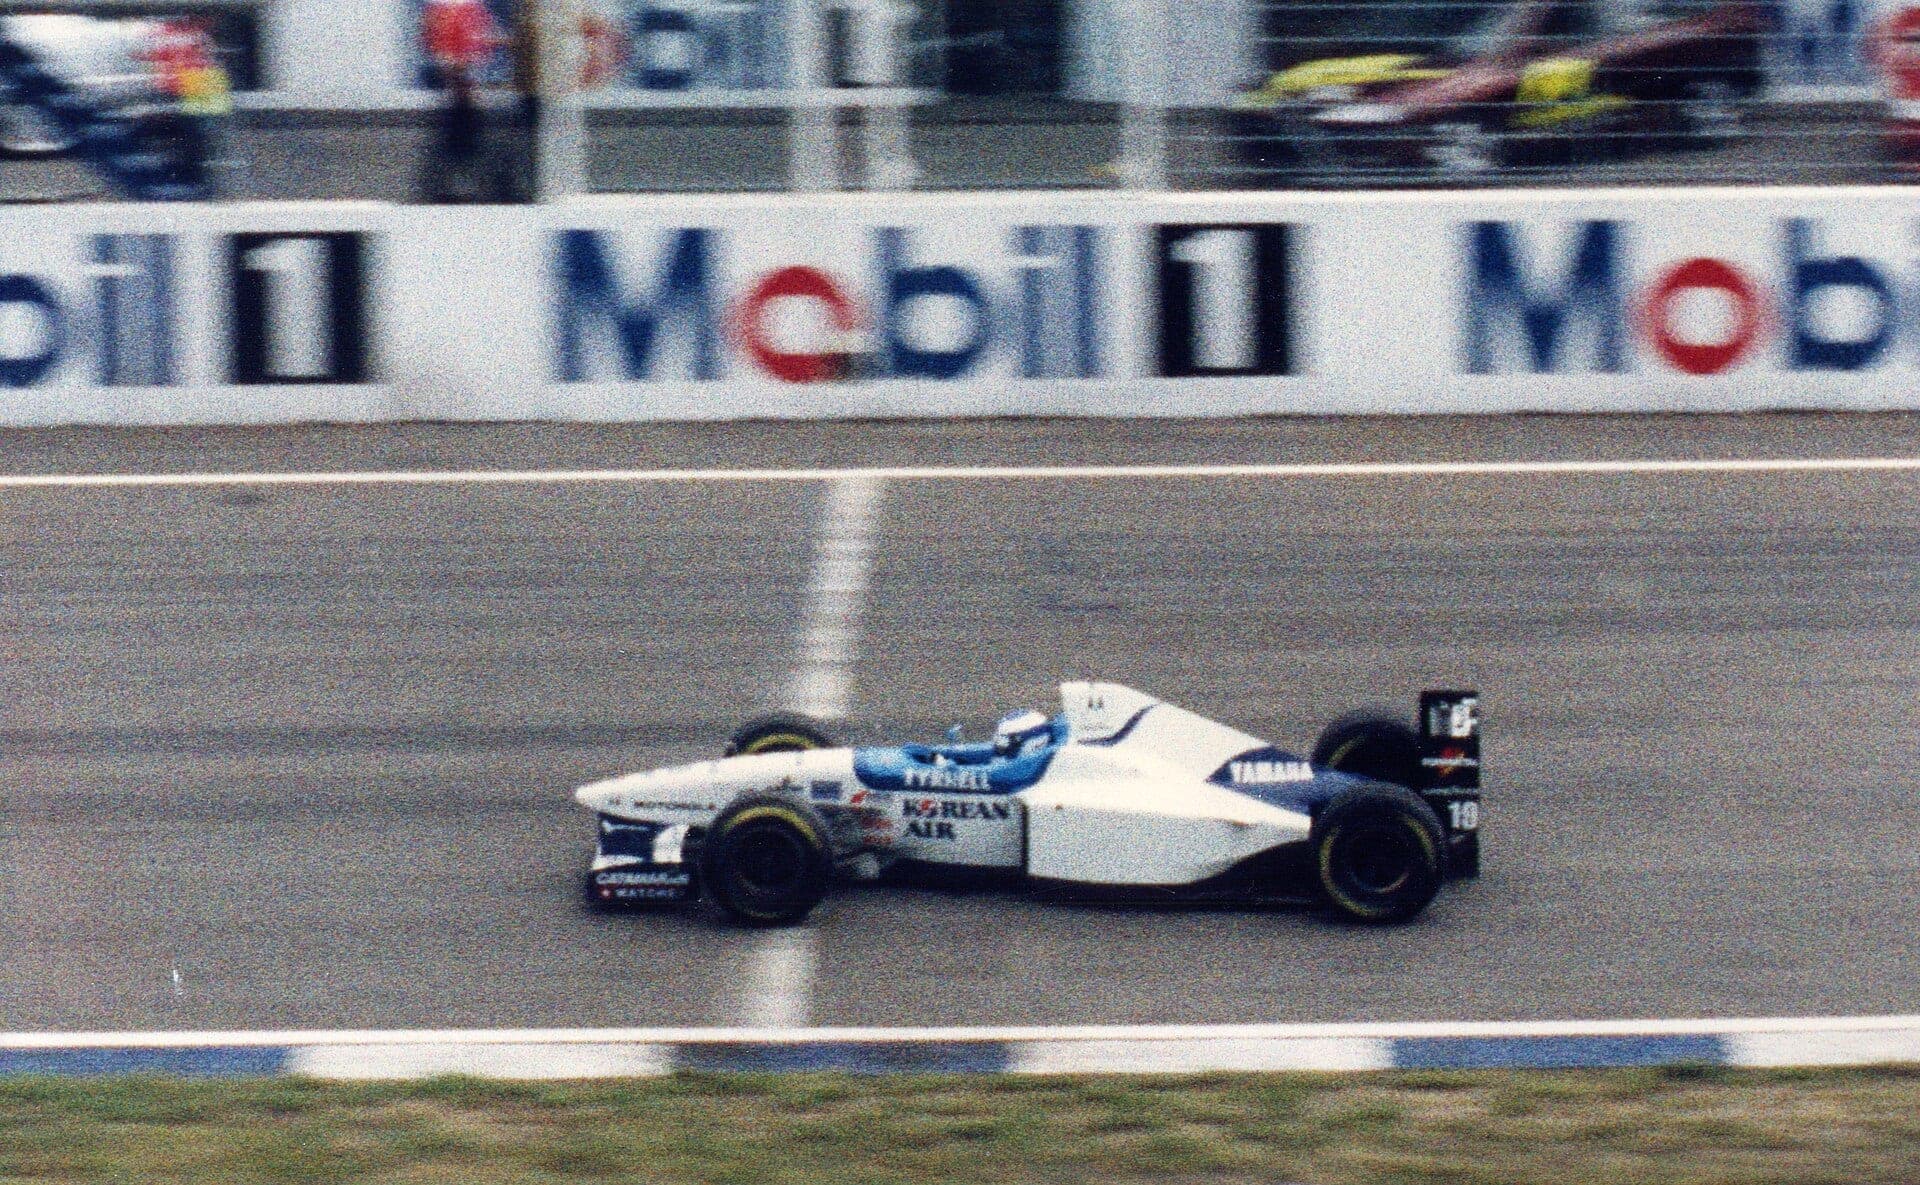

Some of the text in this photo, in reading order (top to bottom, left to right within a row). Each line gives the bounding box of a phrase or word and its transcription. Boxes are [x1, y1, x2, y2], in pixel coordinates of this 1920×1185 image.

[555, 227, 1097, 382] Mobil
[1230, 761, 1314, 783] YAMAHA
[902, 799, 1009, 818] KOREAN
[903, 821, 956, 840] AIR
